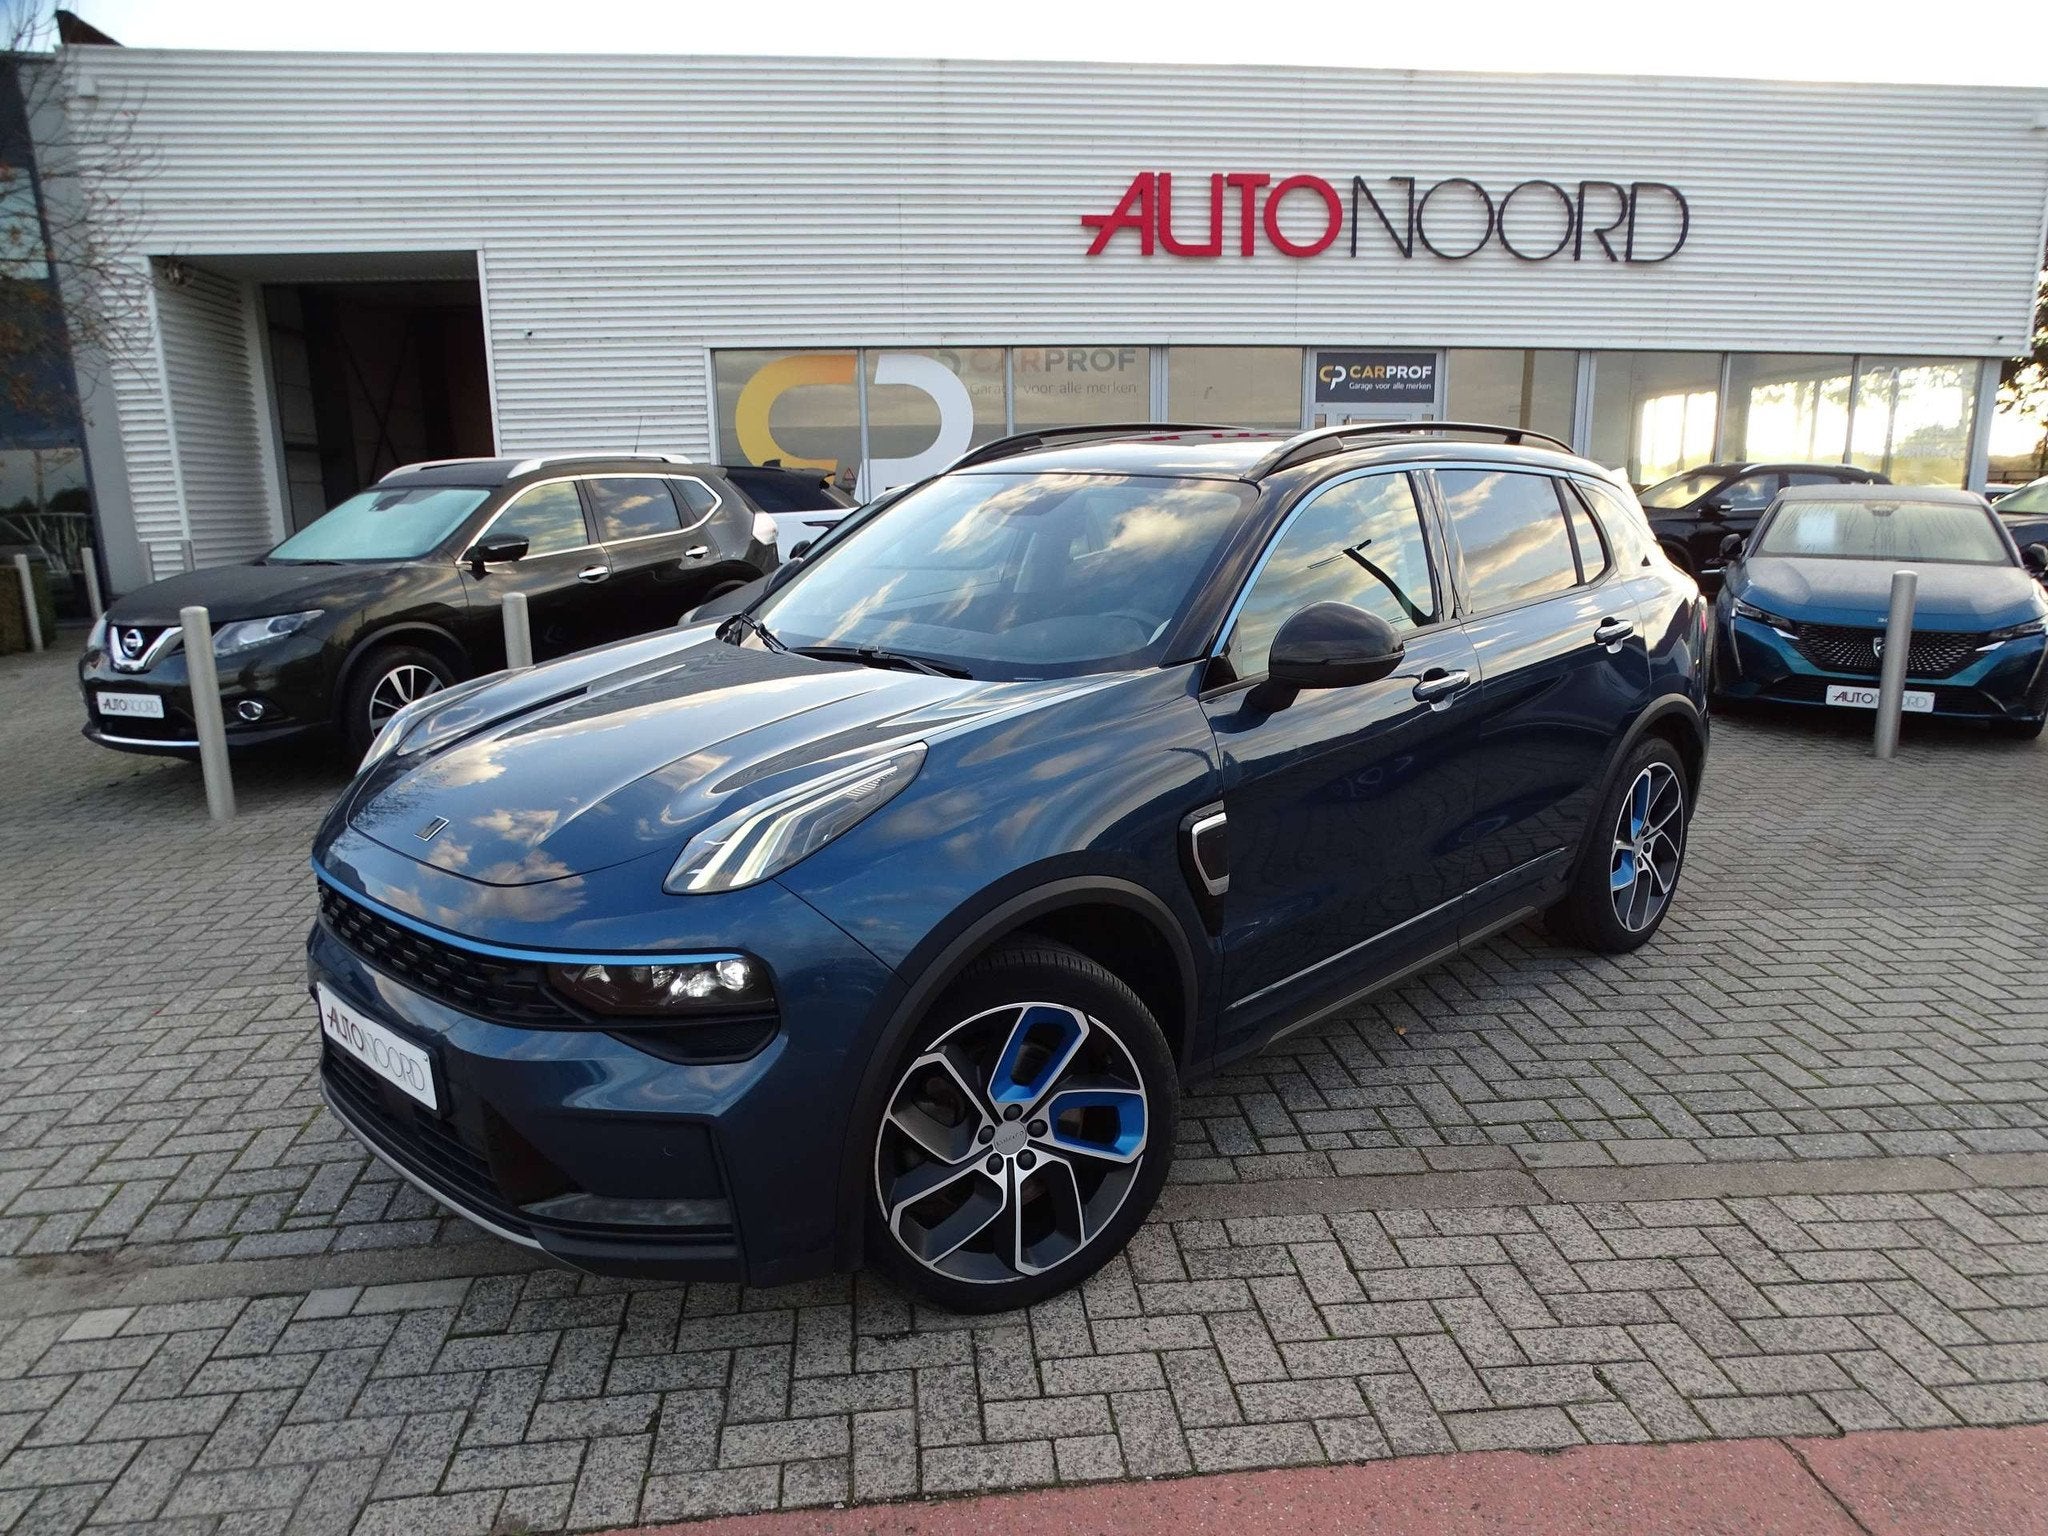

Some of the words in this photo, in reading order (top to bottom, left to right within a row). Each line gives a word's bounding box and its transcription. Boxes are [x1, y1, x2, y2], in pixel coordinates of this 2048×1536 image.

[1349, 365, 1432, 379] CARPROF
[970, 383, 1018, 397] Gara
[1024, 383, 1053, 394] voor
[1059, 381, 1083, 393] alle
[1087, 381, 1137, 393] merken
[1349, 382, 1373, 392] Garage
[1375, 382, 1391, 390] voor
[1392, 381, 1404, 390] alle
[1406, 381, 1431, 390] merken
